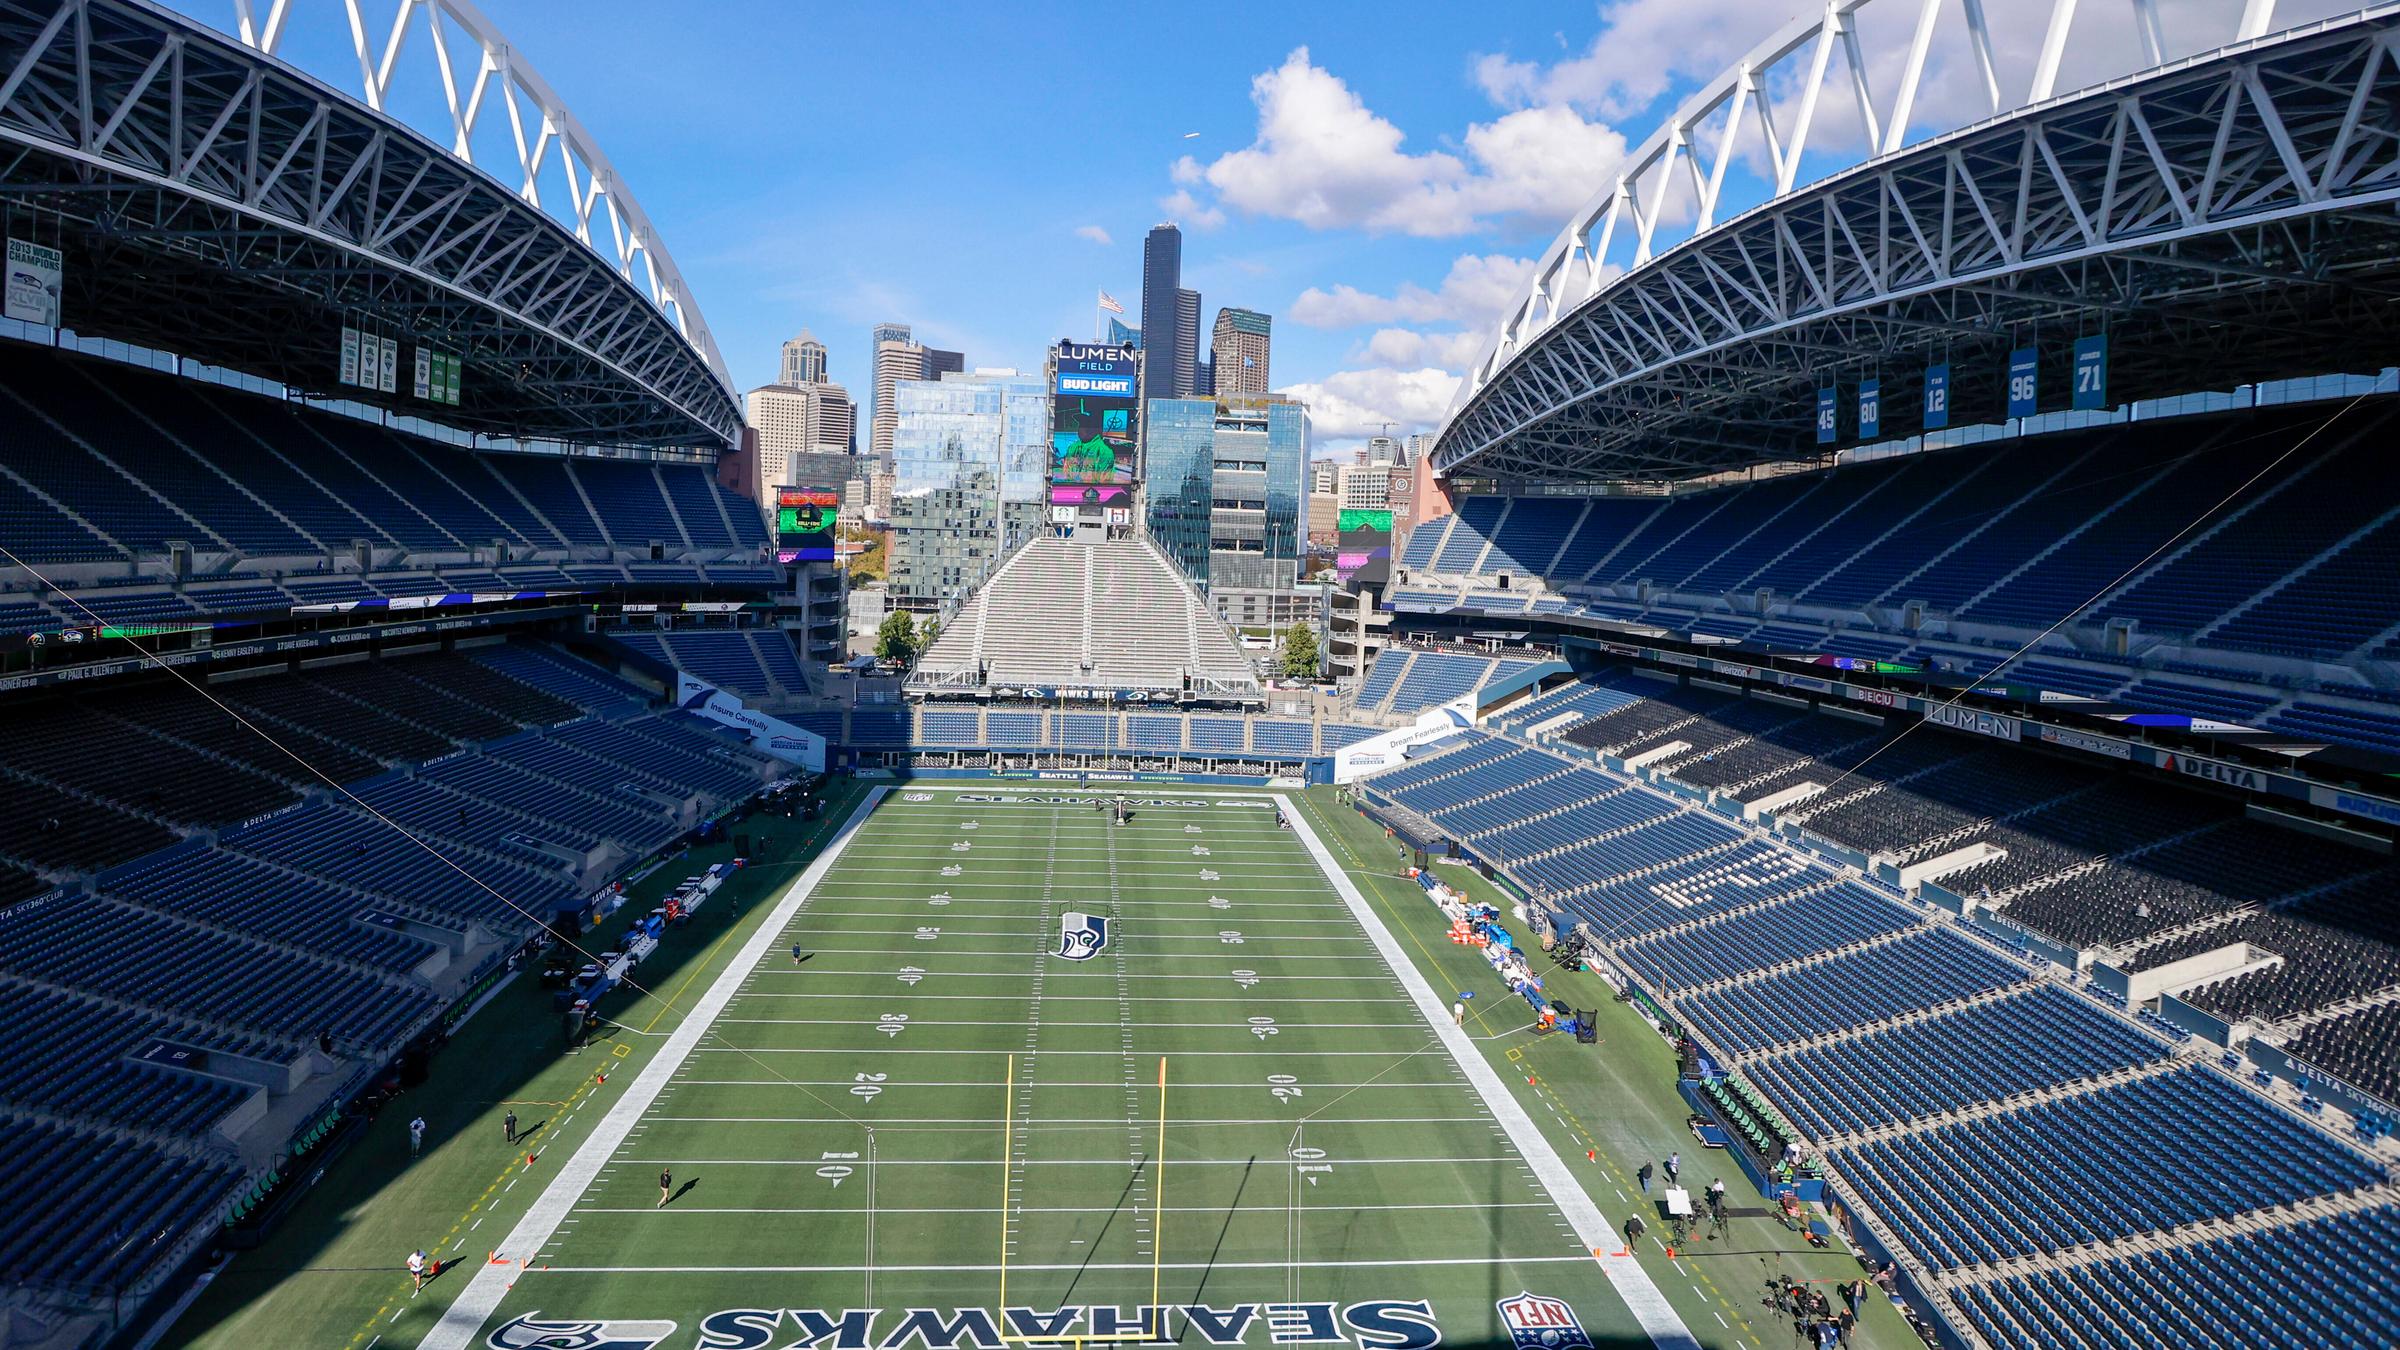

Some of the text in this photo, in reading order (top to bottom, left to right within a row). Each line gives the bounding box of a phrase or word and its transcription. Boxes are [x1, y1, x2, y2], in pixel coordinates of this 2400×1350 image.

[9, 240, 60, 261] 2013 WORLD
[9, 251, 60, 271] CHAMPIONS
[1059, 346, 1134, 361] LUMEN
[1080, 362, 1113, 371] FIELD
[1063, 379, 1128, 392] BUD LIGHT
[2011, 375, 2035, 402] 96
[2079, 365, 2100, 392] 71
[1927, 389, 1945, 412] 12
[1818, 409, 1834, 430] 45
[1861, 401, 1877, 423] 80
[237, 646, 254, 656] EASLEY
[68, 668, 84, 680] PAUL
[92, 665, 110, 677] ALLEN
[140, 660, 149, 669] 79
[1720, 665, 1748, 677] verizon
[1055, 689, 1116, 698] HAWKS NEST
[710, 702, 768, 732] Insure Carefully
[1930, 704, 2012, 738] LUMEN
[1390, 736, 1414, 748] Dream
[1414, 722, 1450, 740] Fearlessly
[2185, 758, 2256, 789] DELTA
[956, 794, 1209, 807] SEAHAWKS
[250, 814, 271, 826] DELTA
[1805, 831, 1823, 843] DELTA
[1997, 916, 2021, 933] DELTA
[876, 1013, 908, 1032] 30
[1247, 1016, 1279, 1035] 30
[850, 1072, 888, 1096] 20
[1267, 1074, 1303, 1097] 20
[2298, 1063, 2341, 1093] DELTA
[815, 1151, 859, 1178] 10
[1292, 1148, 1334, 1173] 10
[1506, 1301, 1571, 1326] NFL
[697, 1299, 1443, 1350] SEAHAWKS
